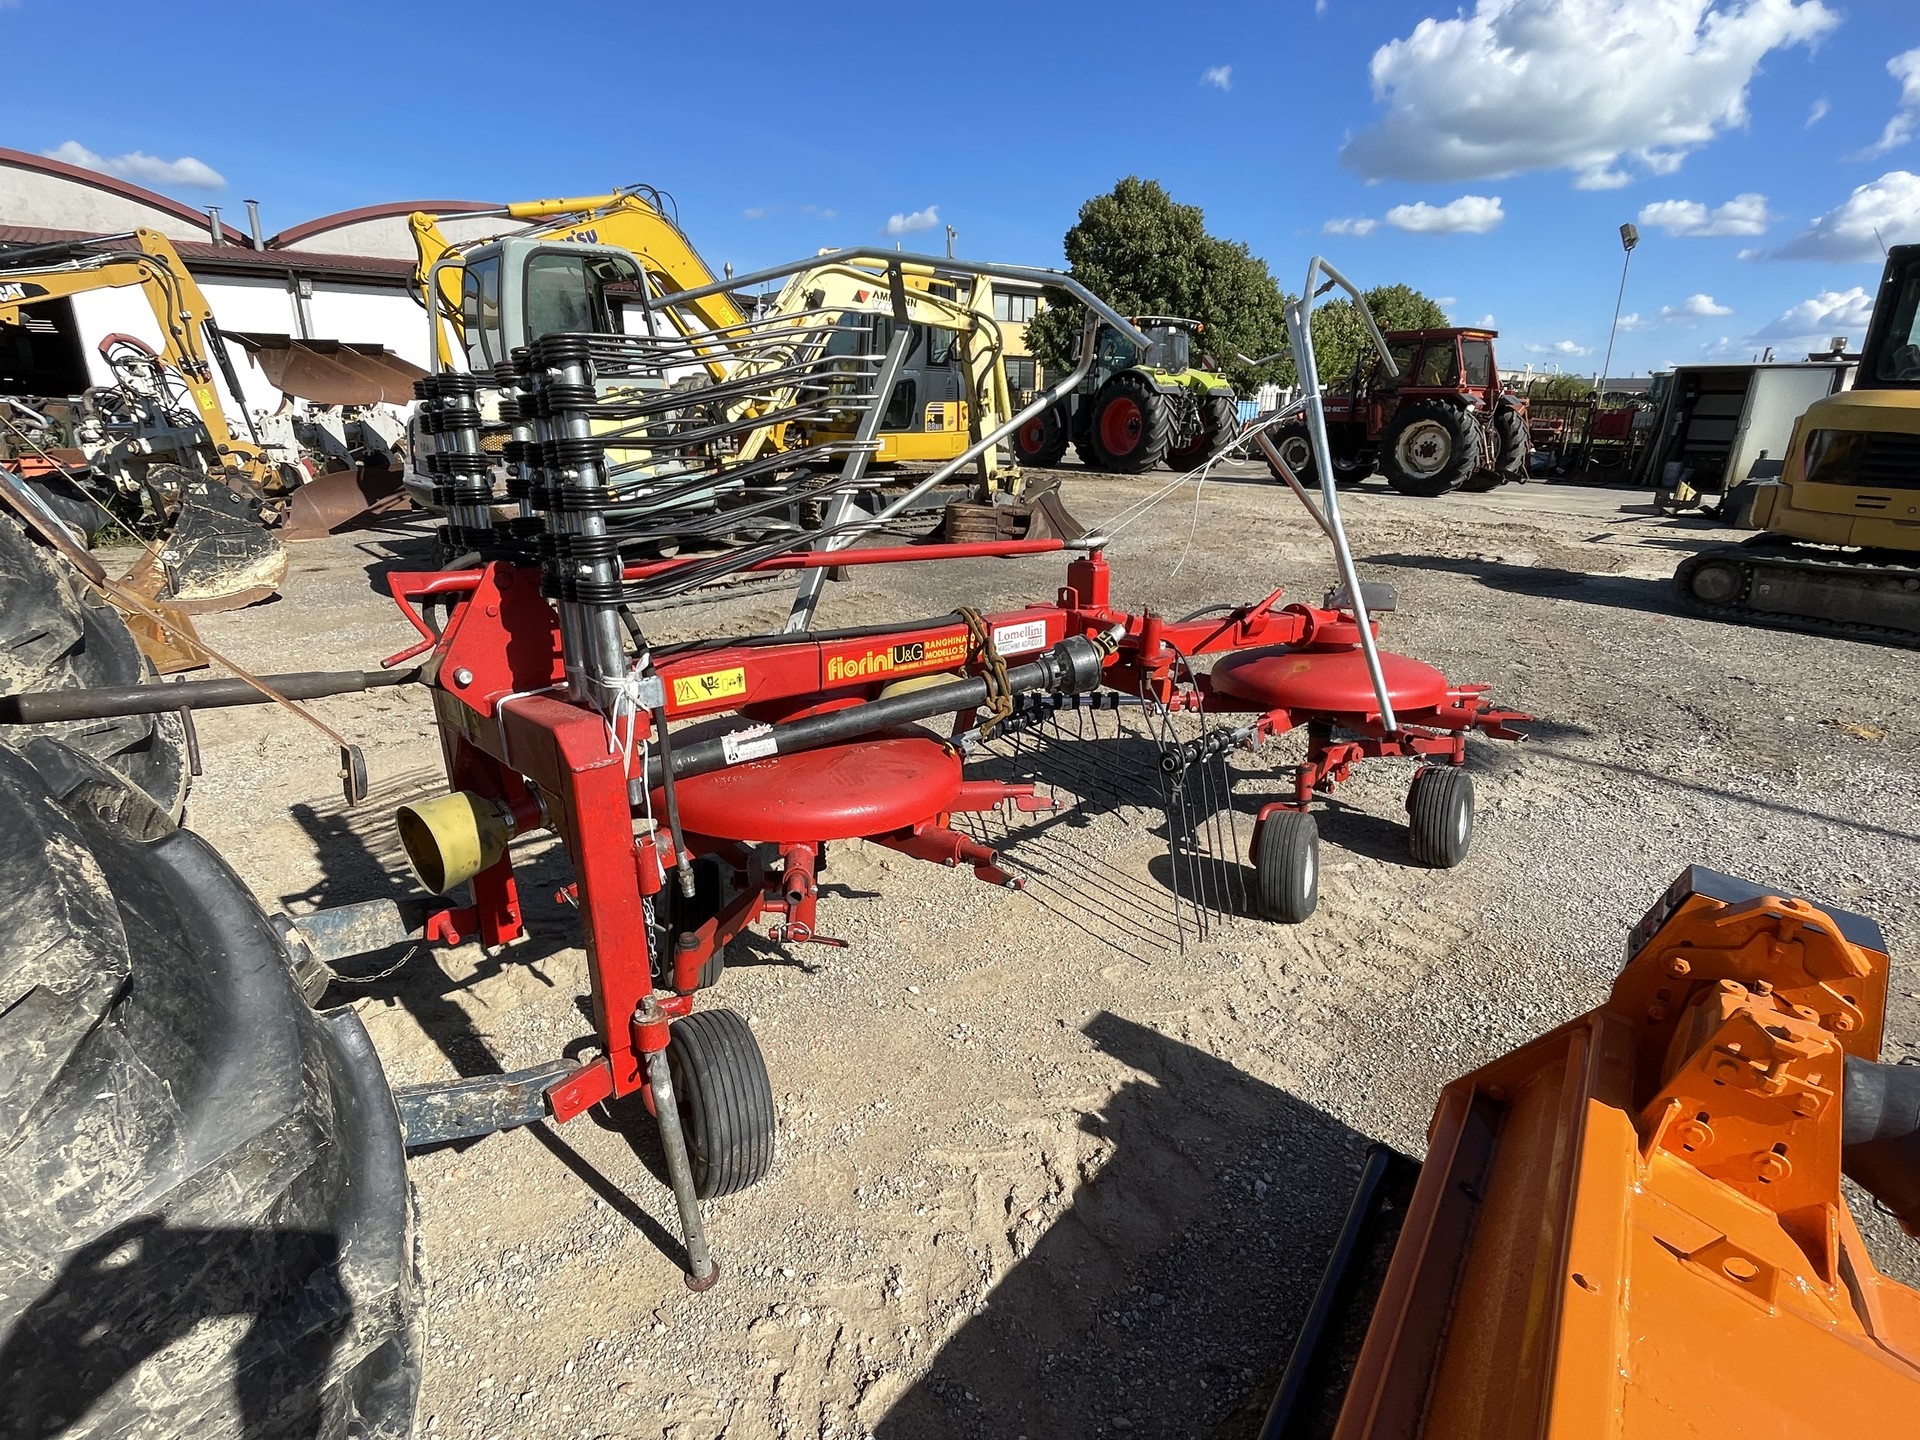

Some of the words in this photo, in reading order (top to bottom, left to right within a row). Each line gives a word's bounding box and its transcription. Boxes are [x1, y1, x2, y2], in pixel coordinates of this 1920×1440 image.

[872, 290, 918, 308] AMNN
[998, 624, 1043, 642] Lomellini
[894, 643, 924, 664] U&G
[925, 646, 959, 660] MODELLO
[997, 642, 1020, 652] MACCHINE
[828, 648, 893, 681] fiorini
